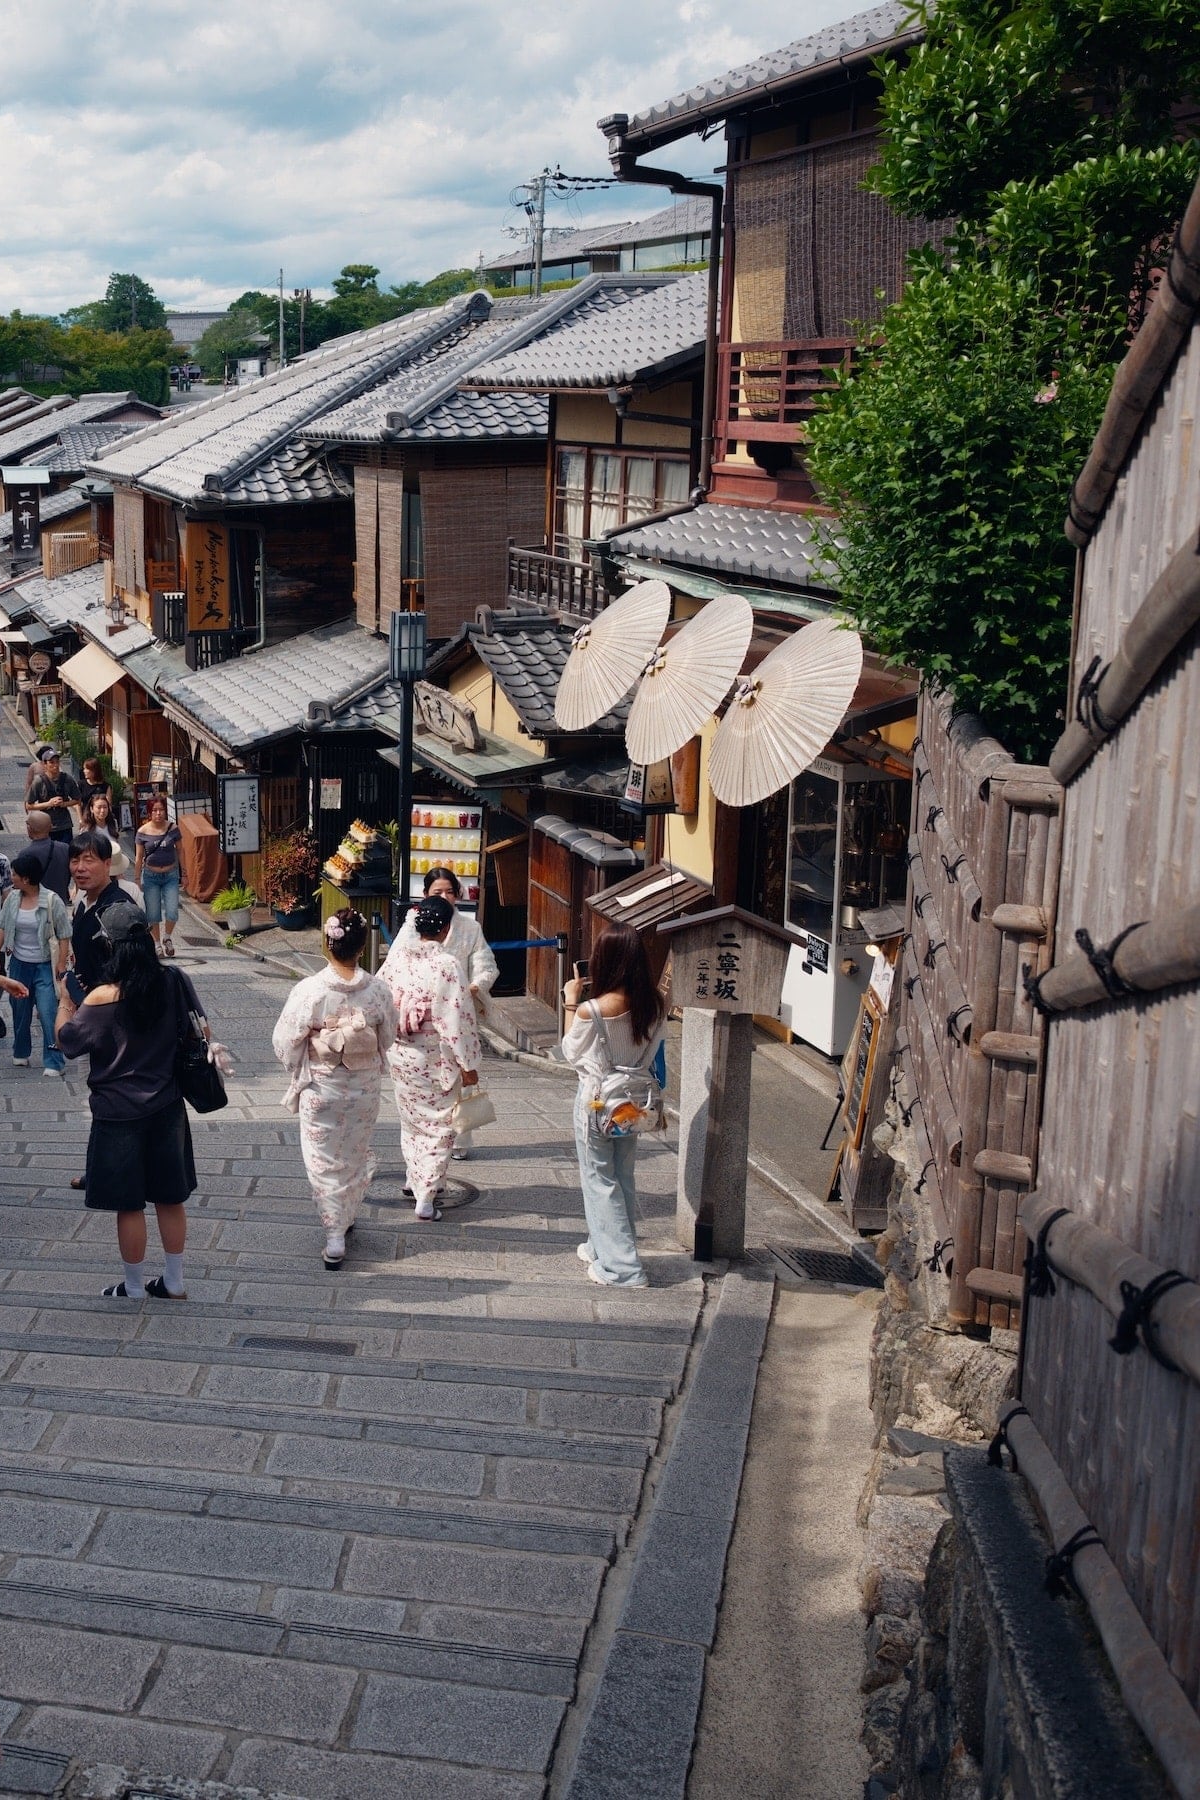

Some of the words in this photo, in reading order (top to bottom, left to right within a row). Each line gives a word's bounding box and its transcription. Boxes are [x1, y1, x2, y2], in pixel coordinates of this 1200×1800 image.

[631, 763, 643, 788] 琲
[226, 816, 239, 846] ふたば
[713, 933, 742, 1001] 二寧坂
